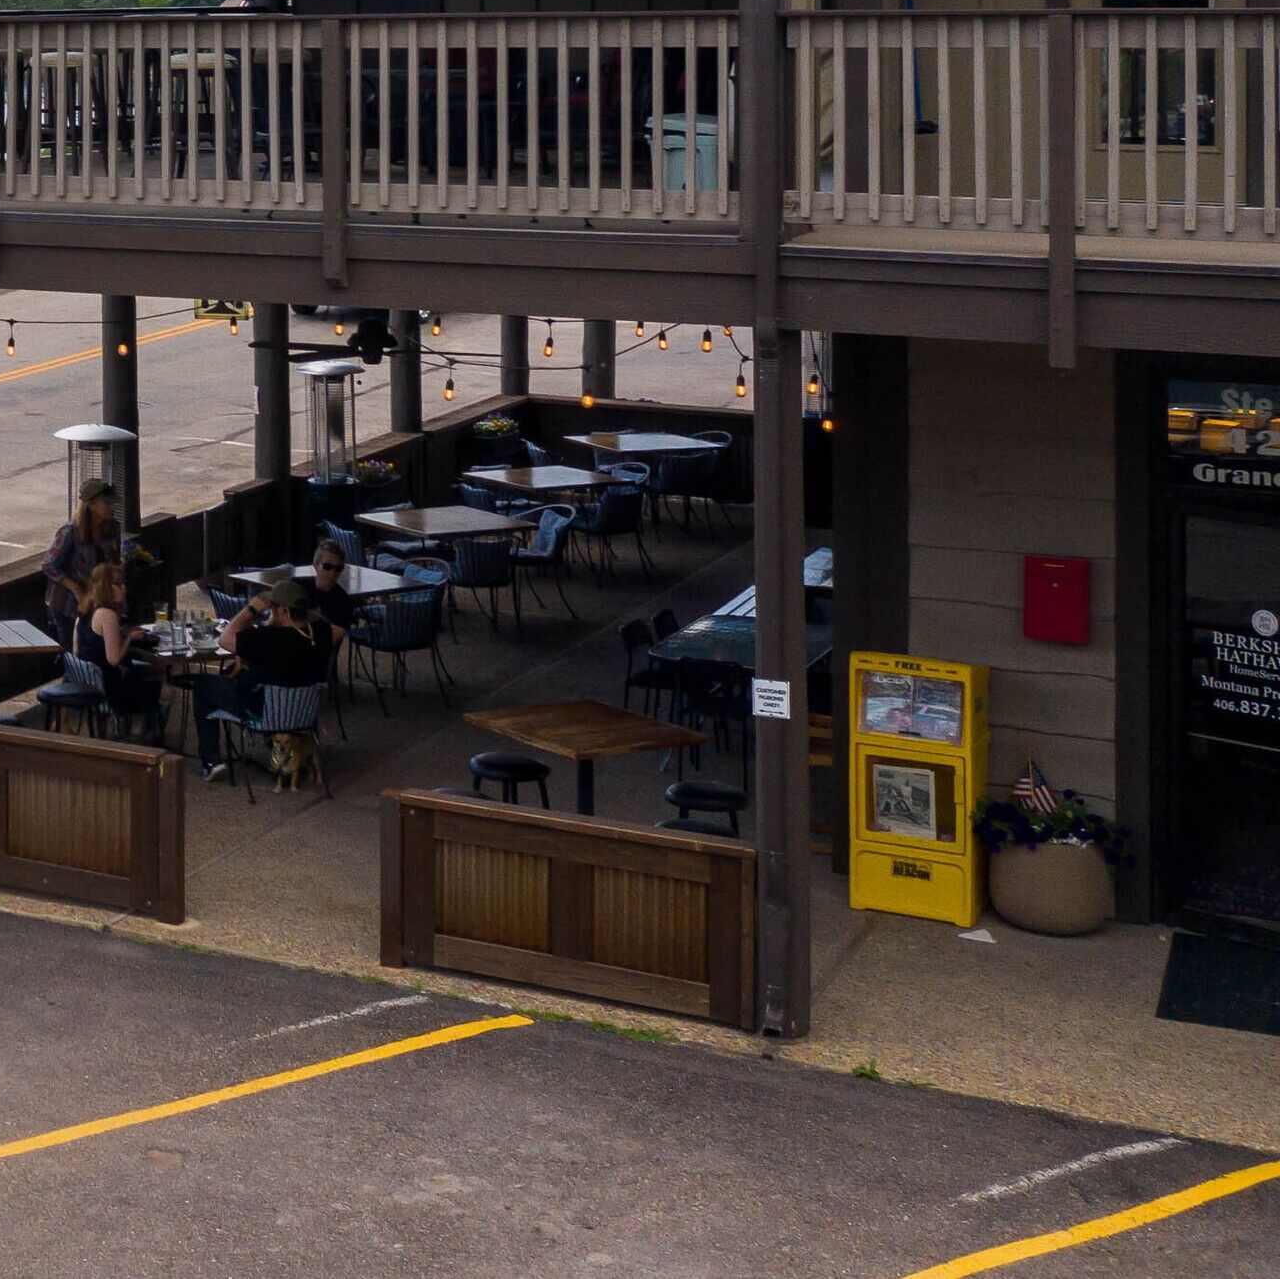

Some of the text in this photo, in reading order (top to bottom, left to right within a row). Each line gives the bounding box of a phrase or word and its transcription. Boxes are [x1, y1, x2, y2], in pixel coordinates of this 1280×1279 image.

[1213, 631, 1280, 655] BERKSH
[894, 661, 922, 672] FREE
[1216, 646, 1280, 671] HATHA
[1201, 674, 1260, 696] Montana
